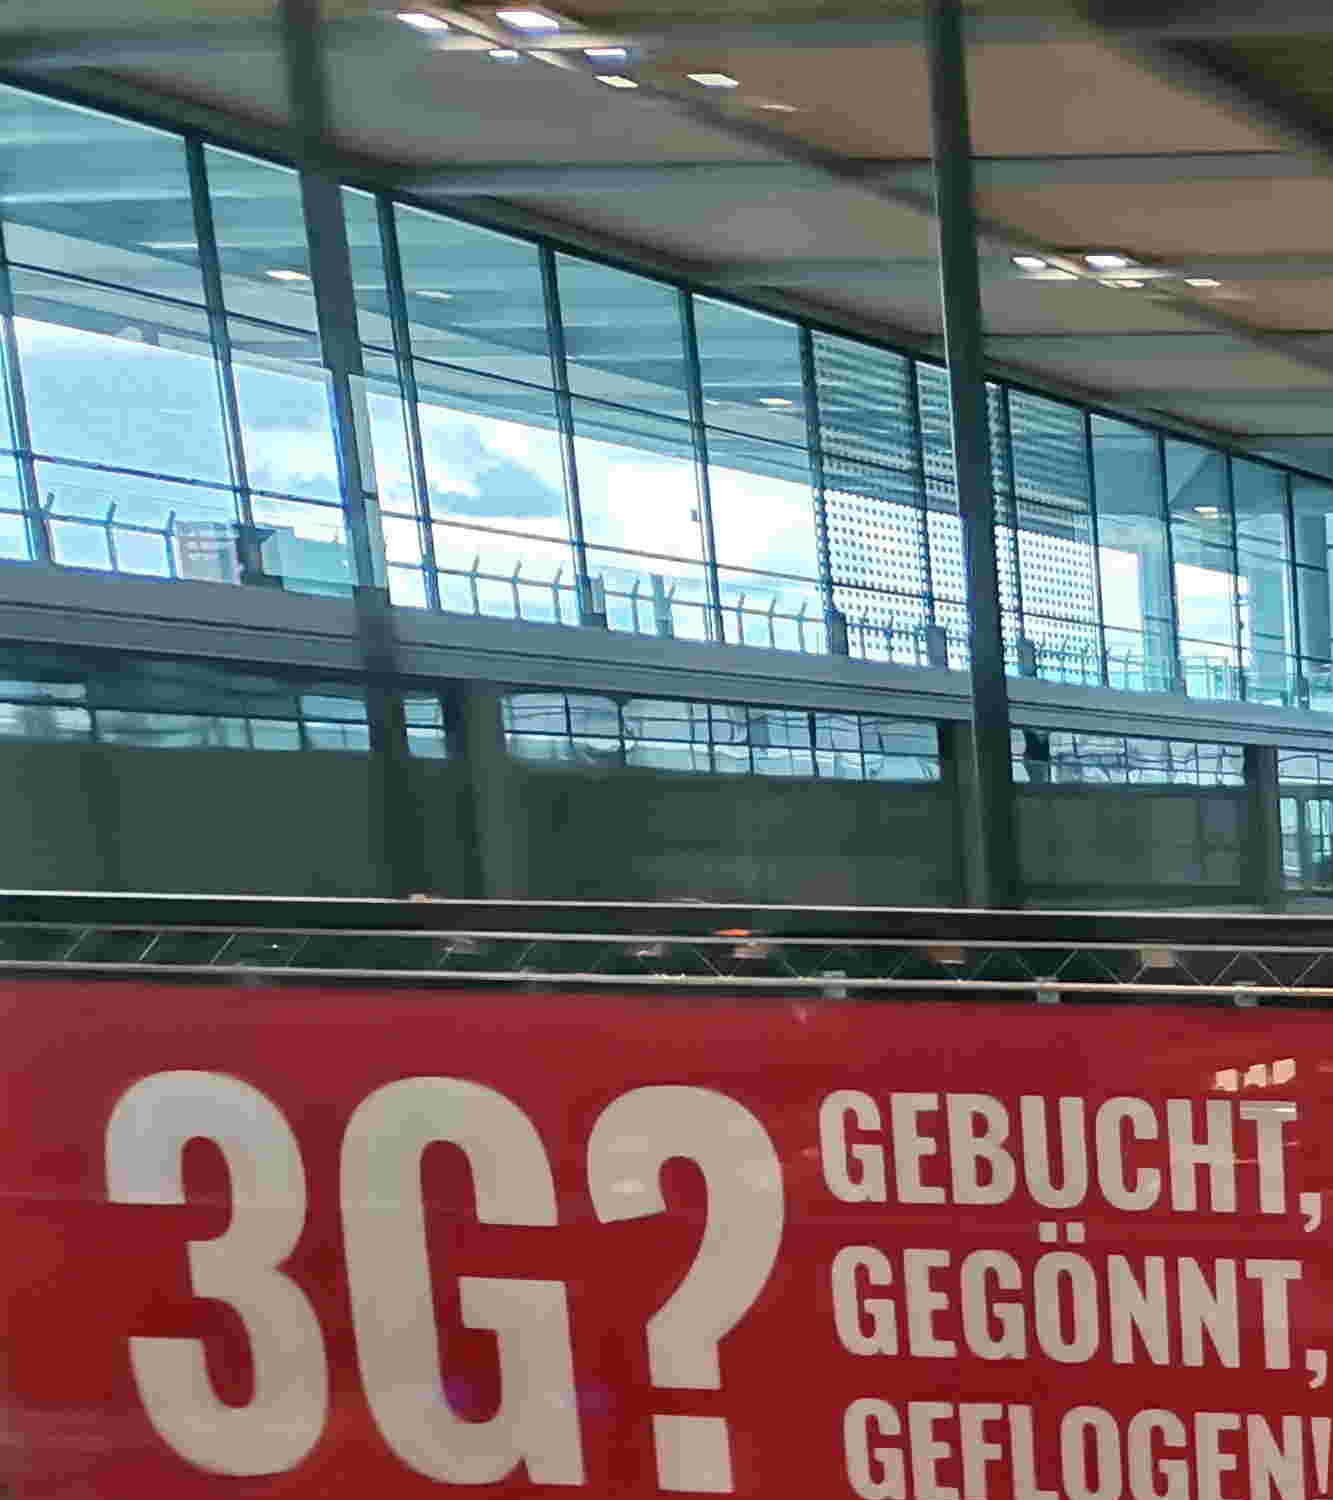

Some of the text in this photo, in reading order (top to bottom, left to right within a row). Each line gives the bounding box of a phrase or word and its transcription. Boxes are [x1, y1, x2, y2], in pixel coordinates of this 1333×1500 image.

[818, 1089, 1322, 1233] GEBUCHT,
[105, 1069, 784, 1494] 3G?
[831, 1221, 1328, 1389] GEGÖNNT,
